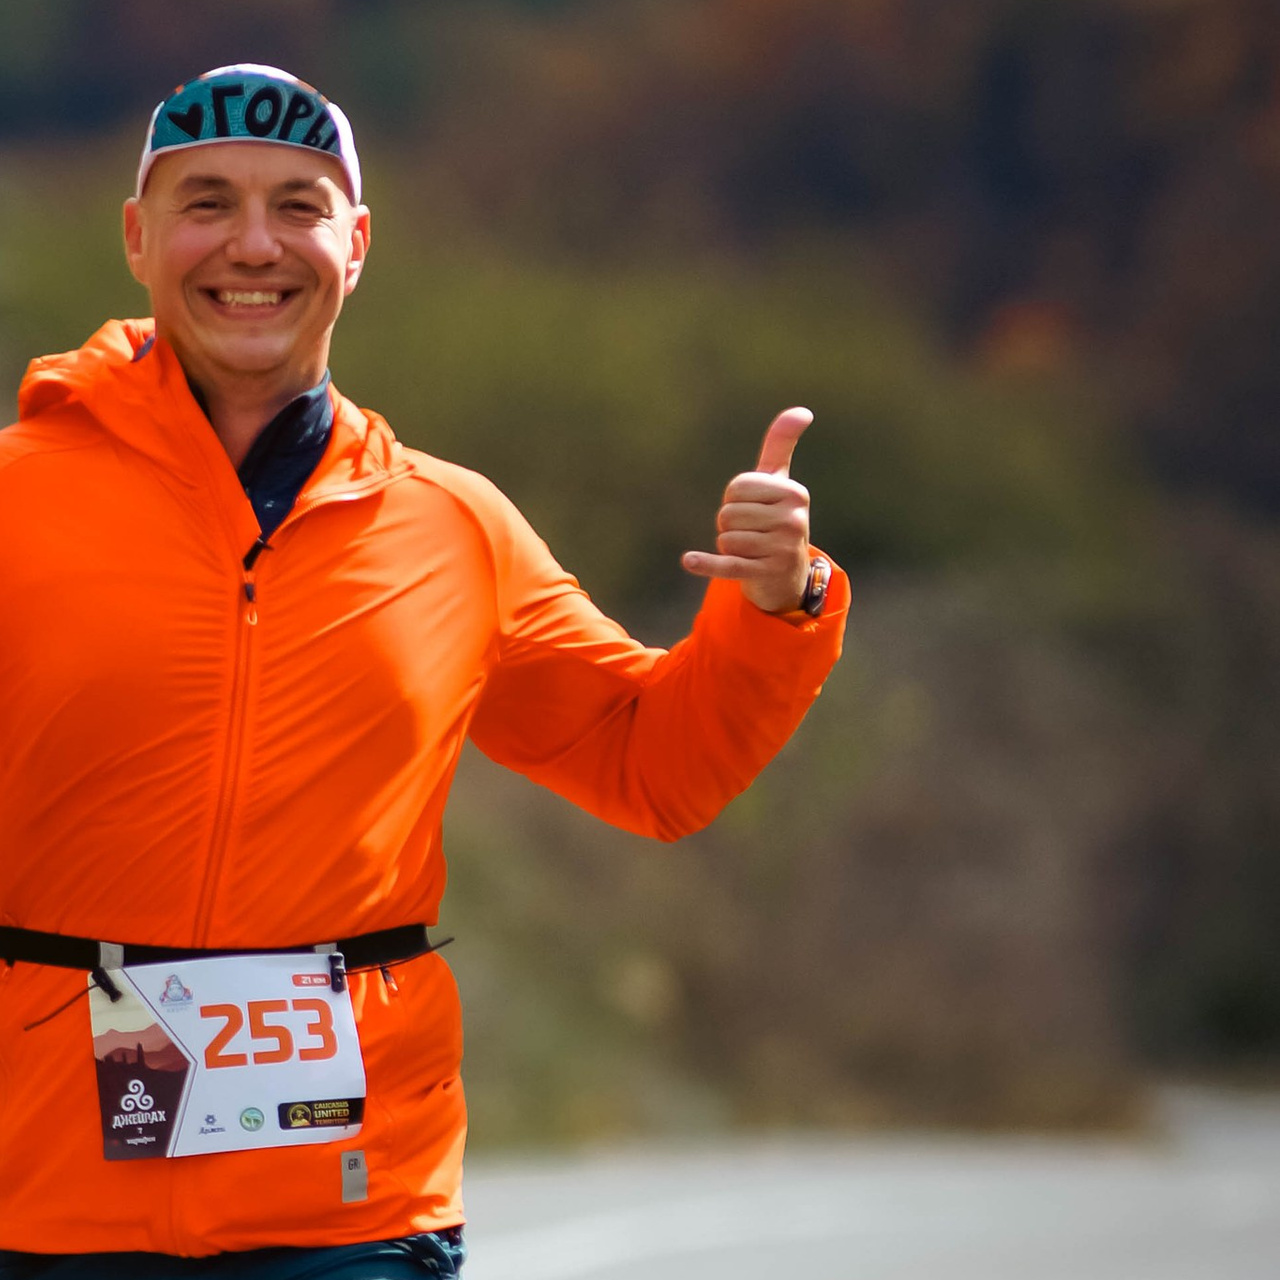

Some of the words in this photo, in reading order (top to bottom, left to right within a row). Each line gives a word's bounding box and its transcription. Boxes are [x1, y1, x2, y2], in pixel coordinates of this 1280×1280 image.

[211, 83, 339, 150] ГОРЫ
[199, 998, 339, 1070] 253
[313, 1108, 350, 1119] UNITED
